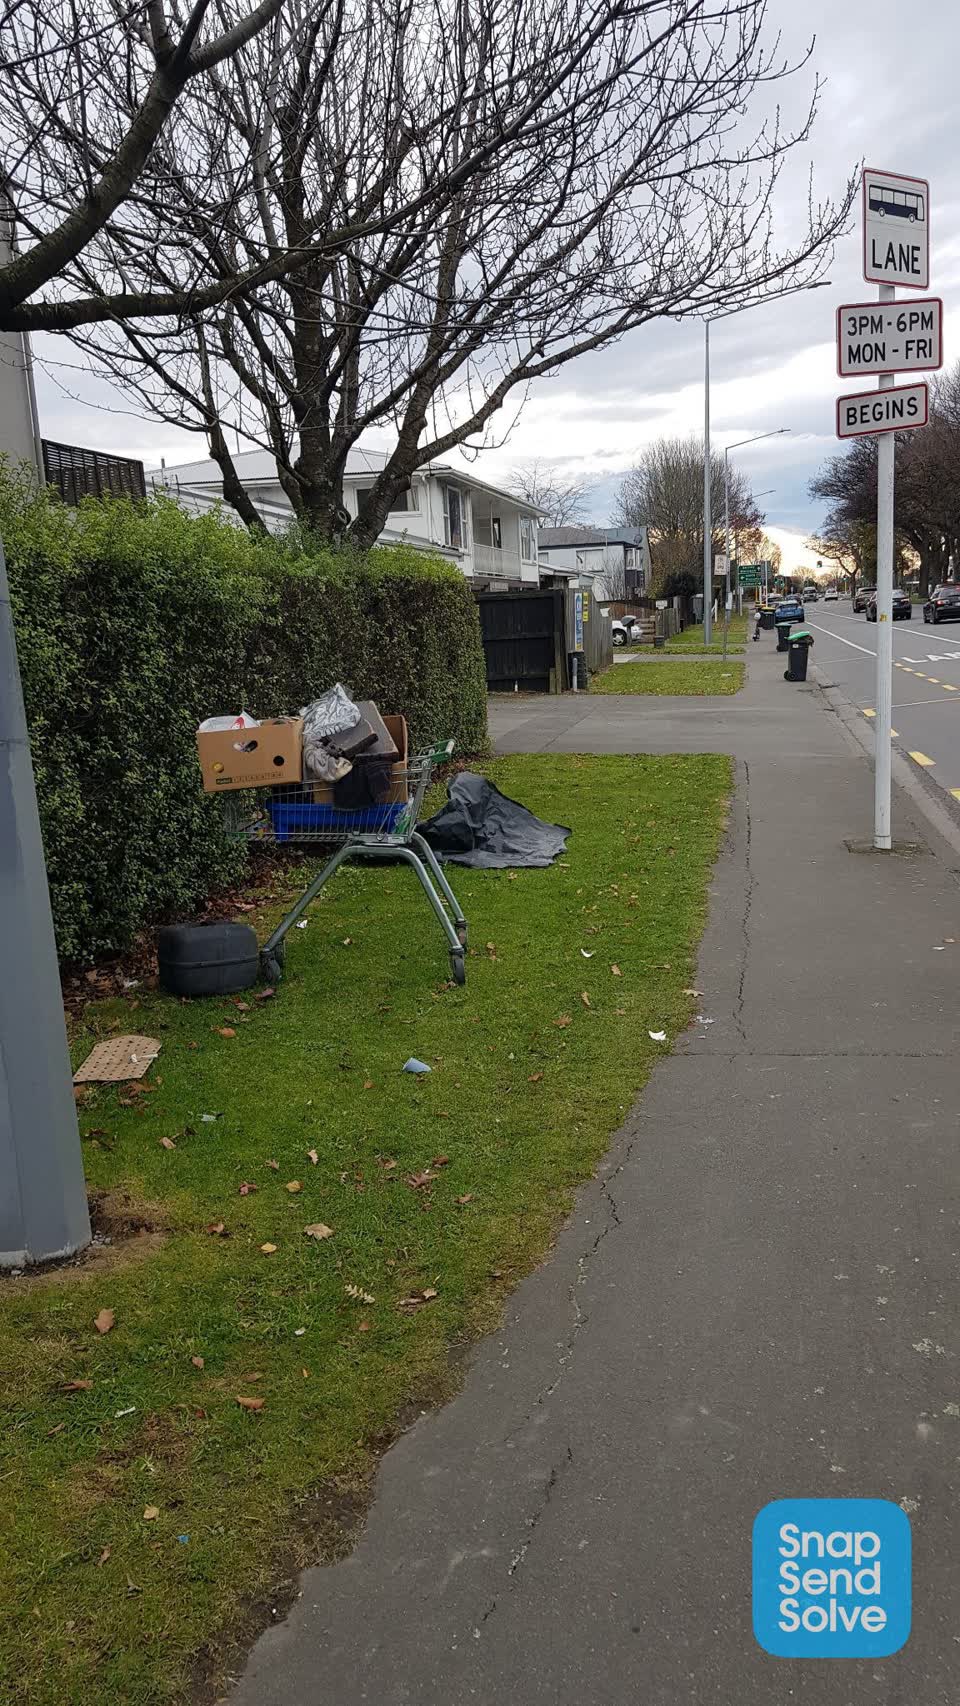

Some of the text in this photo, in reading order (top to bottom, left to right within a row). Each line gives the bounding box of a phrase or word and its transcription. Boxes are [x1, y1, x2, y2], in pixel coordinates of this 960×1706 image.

[871, 238, 921, 275] LANE
[847, 314, 883, 336] 3PM
[896, 310, 934, 333] 6PM
[847, 341, 886, 365] MON
[905, 338, 932, 360] FRI
[846, 396, 918, 426] BEGINS
